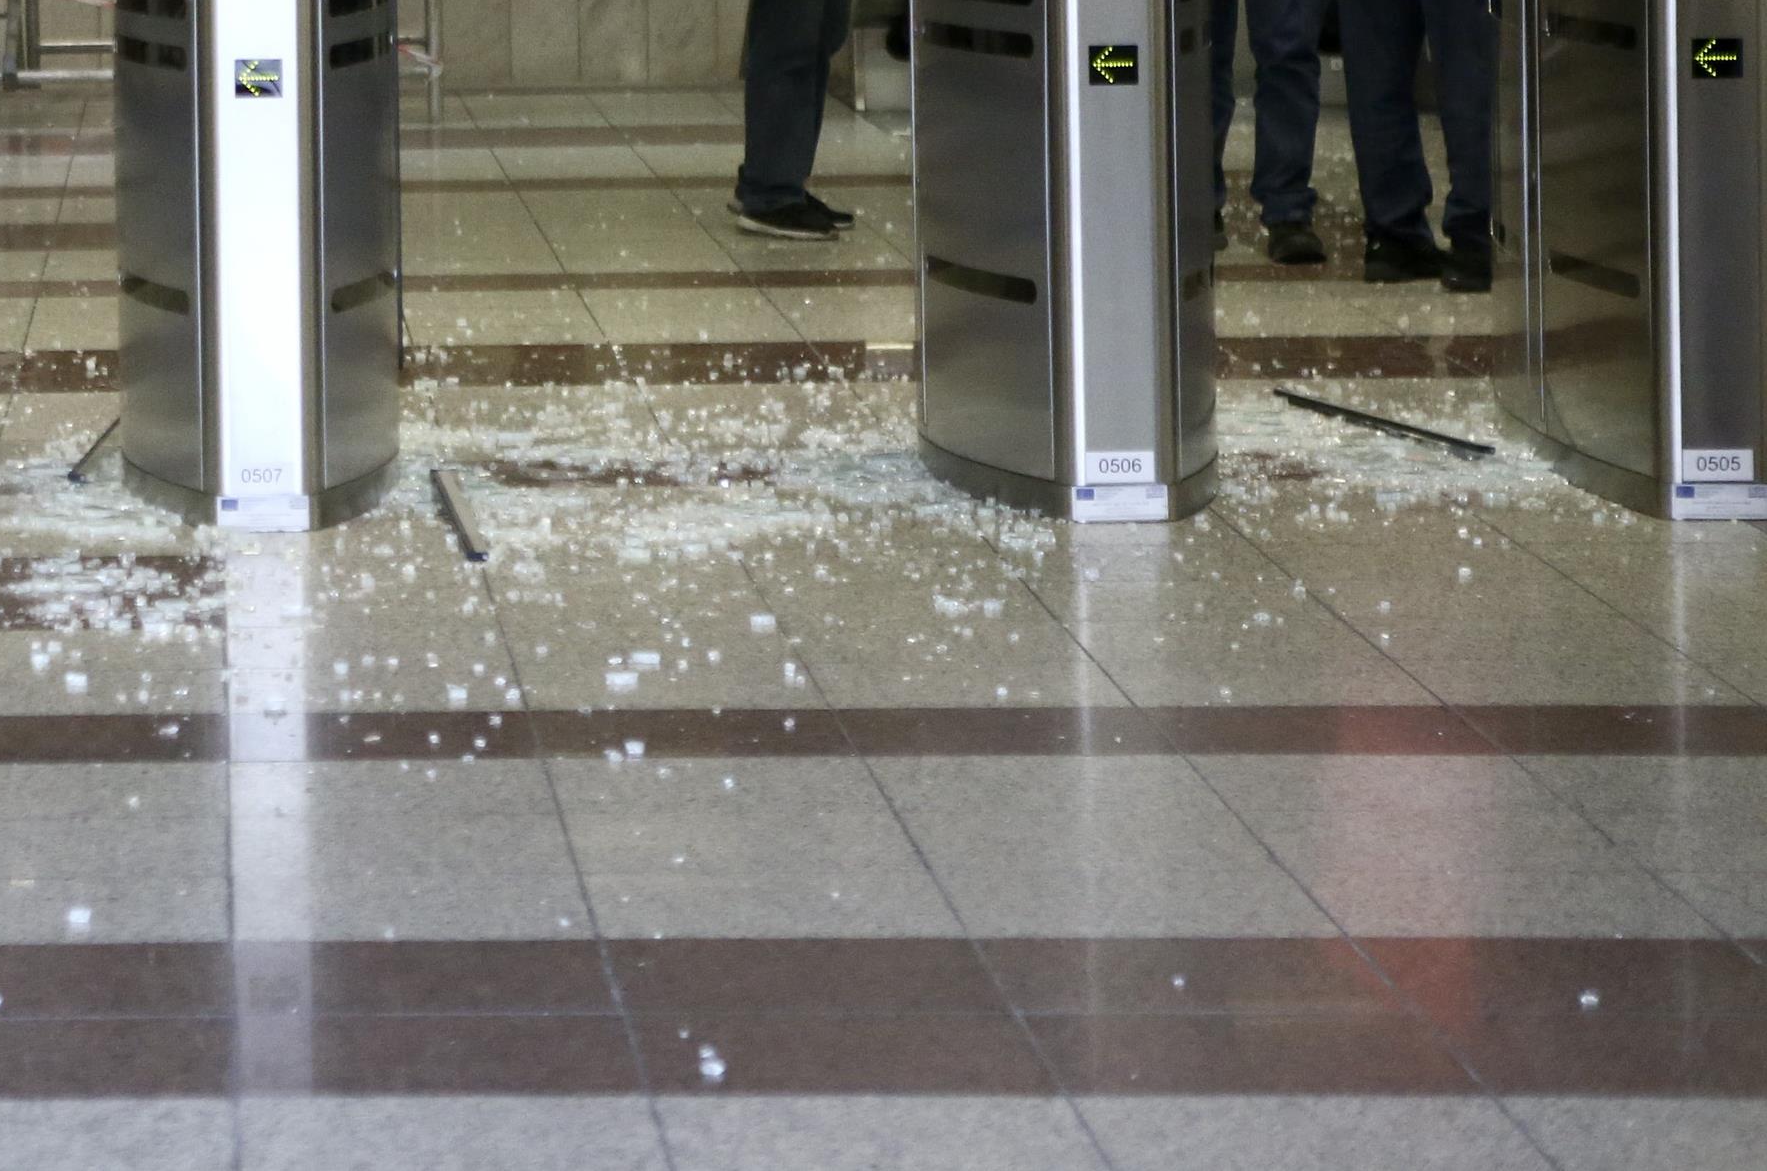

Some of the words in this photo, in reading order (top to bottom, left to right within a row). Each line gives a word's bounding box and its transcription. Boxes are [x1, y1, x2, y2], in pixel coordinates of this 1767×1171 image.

[1098, 458, 1143, 474] 0506
[1696, 455, 1742, 472] 0505
[240, 468, 283, 484] 0507
